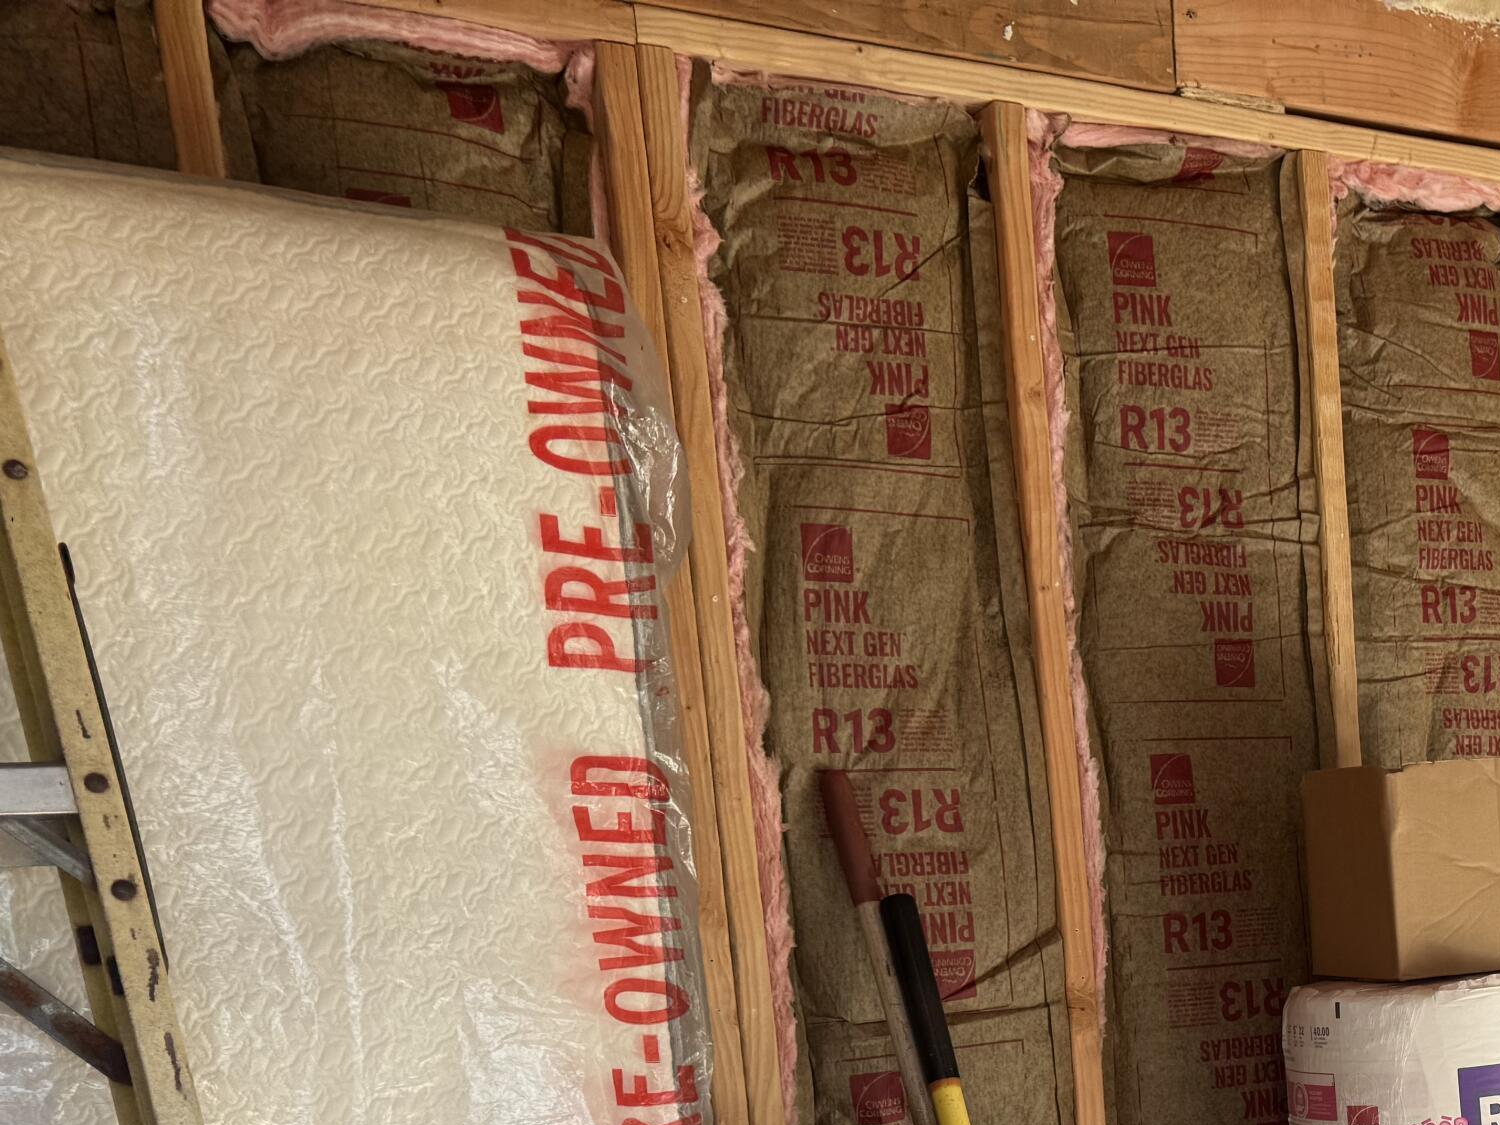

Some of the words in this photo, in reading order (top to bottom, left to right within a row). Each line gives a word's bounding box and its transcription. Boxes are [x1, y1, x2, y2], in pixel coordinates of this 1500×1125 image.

[761, 97, 878, 139] FIBERGLAS
[765, 146, 858, 186] R13
[842, 226, 921, 281] R13
[1411, 238, 1485, 261] BERGLAS
[1429, 265, 1460, 288] GEN
[1463, 268, 1495, 291] NEXT
[818, 291, 923, 327] FIBERGLAS
[1112, 293, 1172, 327] PINK
[1457, 293, 1499, 326] PINK
[835, 324, 876, 354] GEN
[883, 329, 926, 358] NEXT
[1116, 331, 1163, 354] NEXT
[1166, 334, 1200, 359] GEN
[869, 361, 930, 398] PINK
[1118, 360, 1213, 391] FIBERGLAS
[1120, 405, 1191, 453] R13
[1178, 486, 1245, 529] R13
[1416, 485, 1462, 514] PINK
[1417, 520, 1452, 542] NEXT
[1457, 522, 1482, 543] GEN
[1158, 541, 1247, 568] FIBERGLAS
[1418, 548, 1493, 571] FIBERGLAS
[1173, 571, 1206, 595] GEN
[1212, 573, 1252, 596] NEXT
[803, 588, 871, 625] PINK
[1201, 602, 1253, 632] PINK
[1420, 585, 1477, 624] R13
[806, 630, 856, 656] NEXT
[863, 631, 902, 657] GEN
[808, 662, 919, 689] FIBERGLAS
[811, 707, 897, 754] R13
[1455, 735, 1482, 756] GEN
[879, 788, 965, 834] R13
[1155, 809, 1212, 840] PINK
[870, 850, 970, 878] FIBERGLA
[1159, 845, 1199, 868] NEXT
[1206, 844, 1238, 866] GEN
[923, 881, 972, 907] NEXT
[1160, 870, 1253, 896] FIBERGLAS
[923, 911, 976, 943] PIN
[1163, 909, 1233, 954] R13
[1220, 978, 1284, 1022] R13
[1200, 1034, 1283, 1062] IBERGLAS
[1213, 1064, 1247, 1089] GEN
